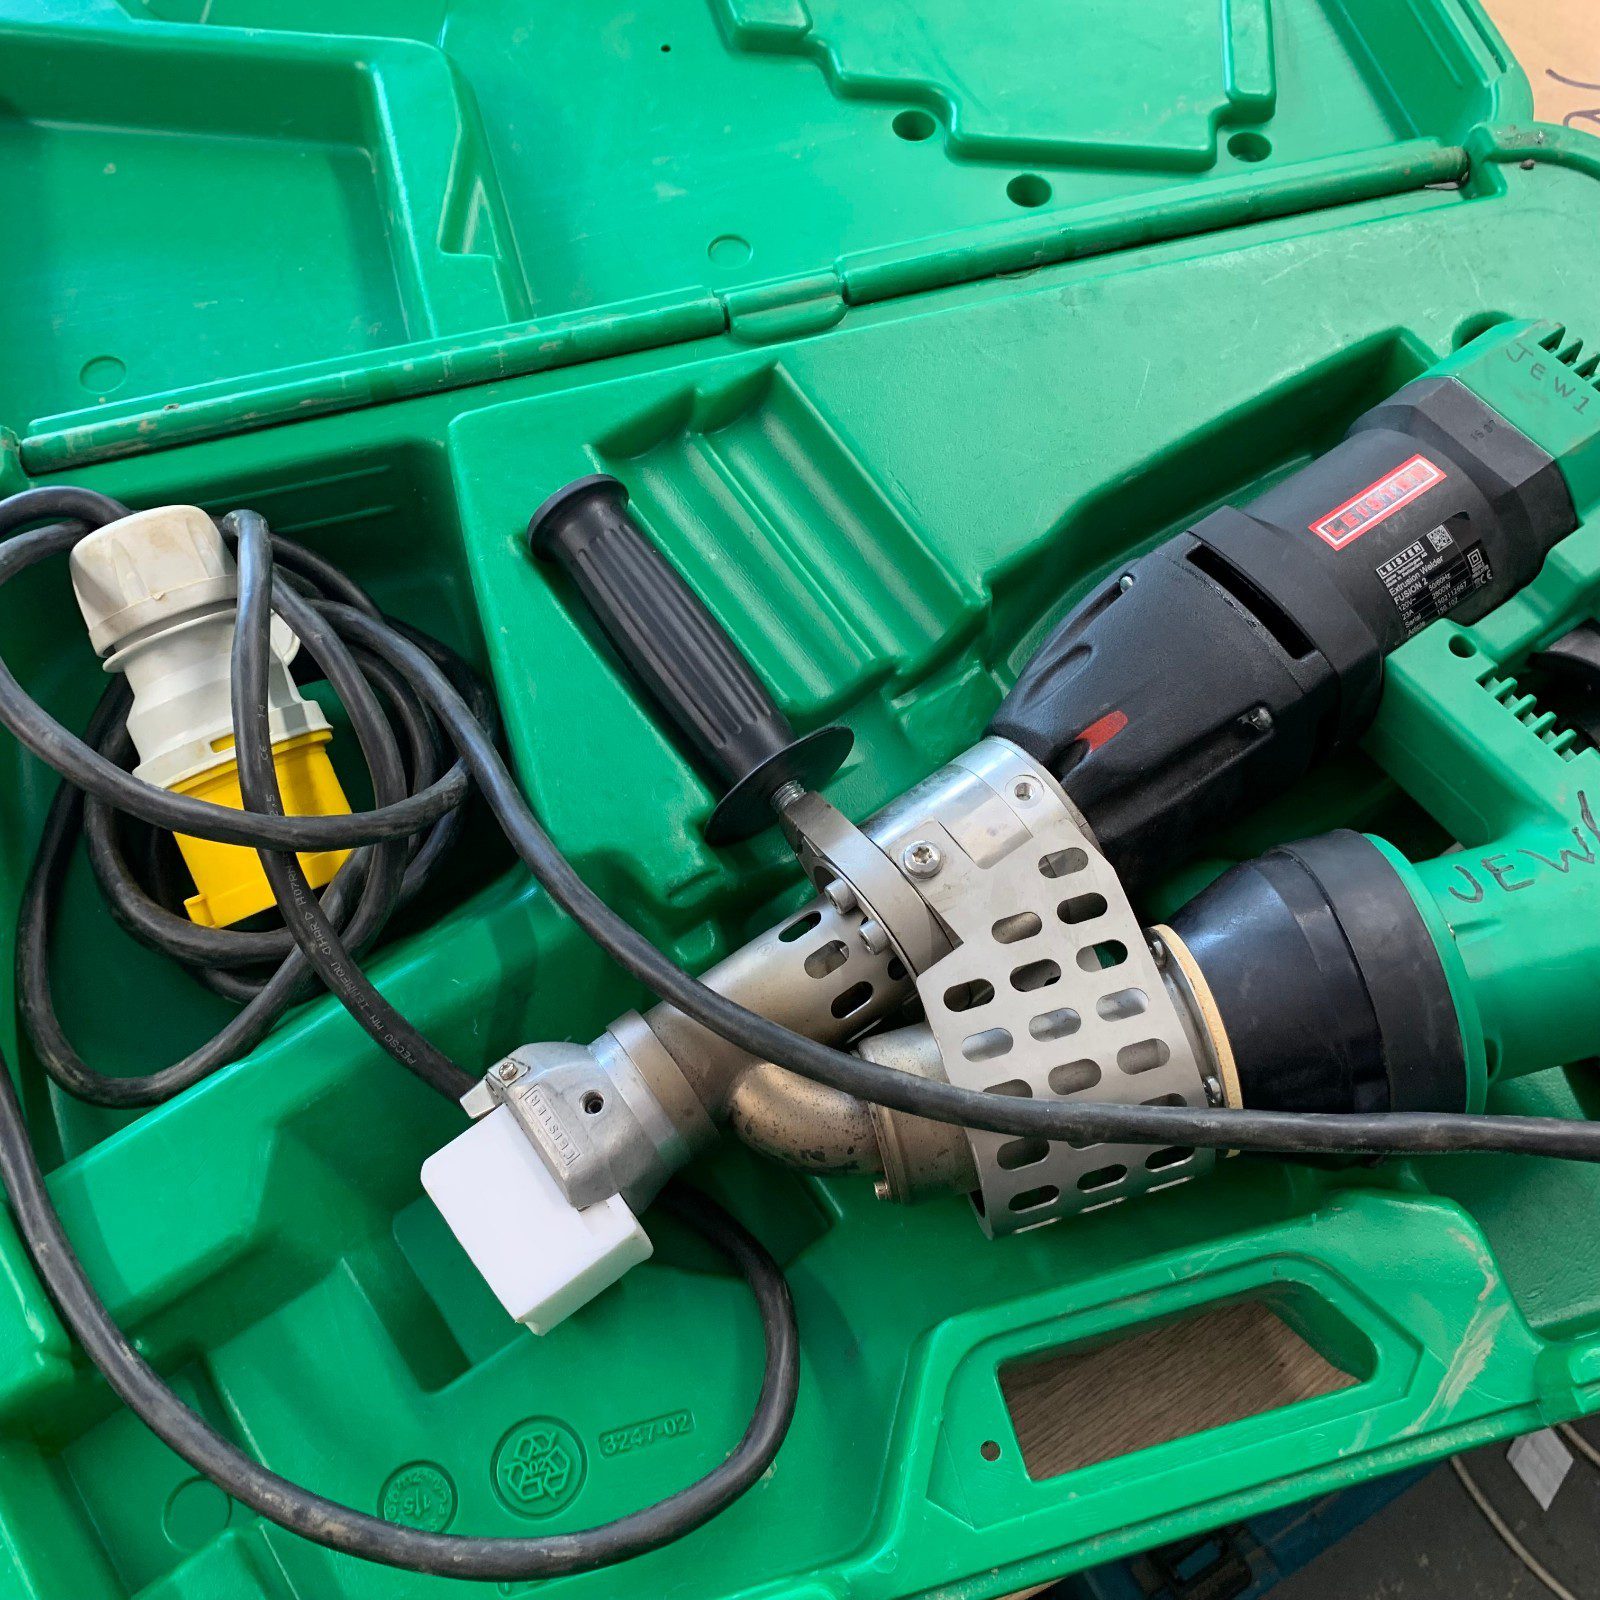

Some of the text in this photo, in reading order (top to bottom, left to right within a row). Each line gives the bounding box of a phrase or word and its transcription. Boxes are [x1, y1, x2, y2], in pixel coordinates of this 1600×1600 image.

[1379, 543, 1422, 576] LEISTER
[1389, 556, 1444, 597] Extrusion Welder
[1394, 577, 1428, 604] FUSION 2
[1404, 613, 1422, 628] Serial
